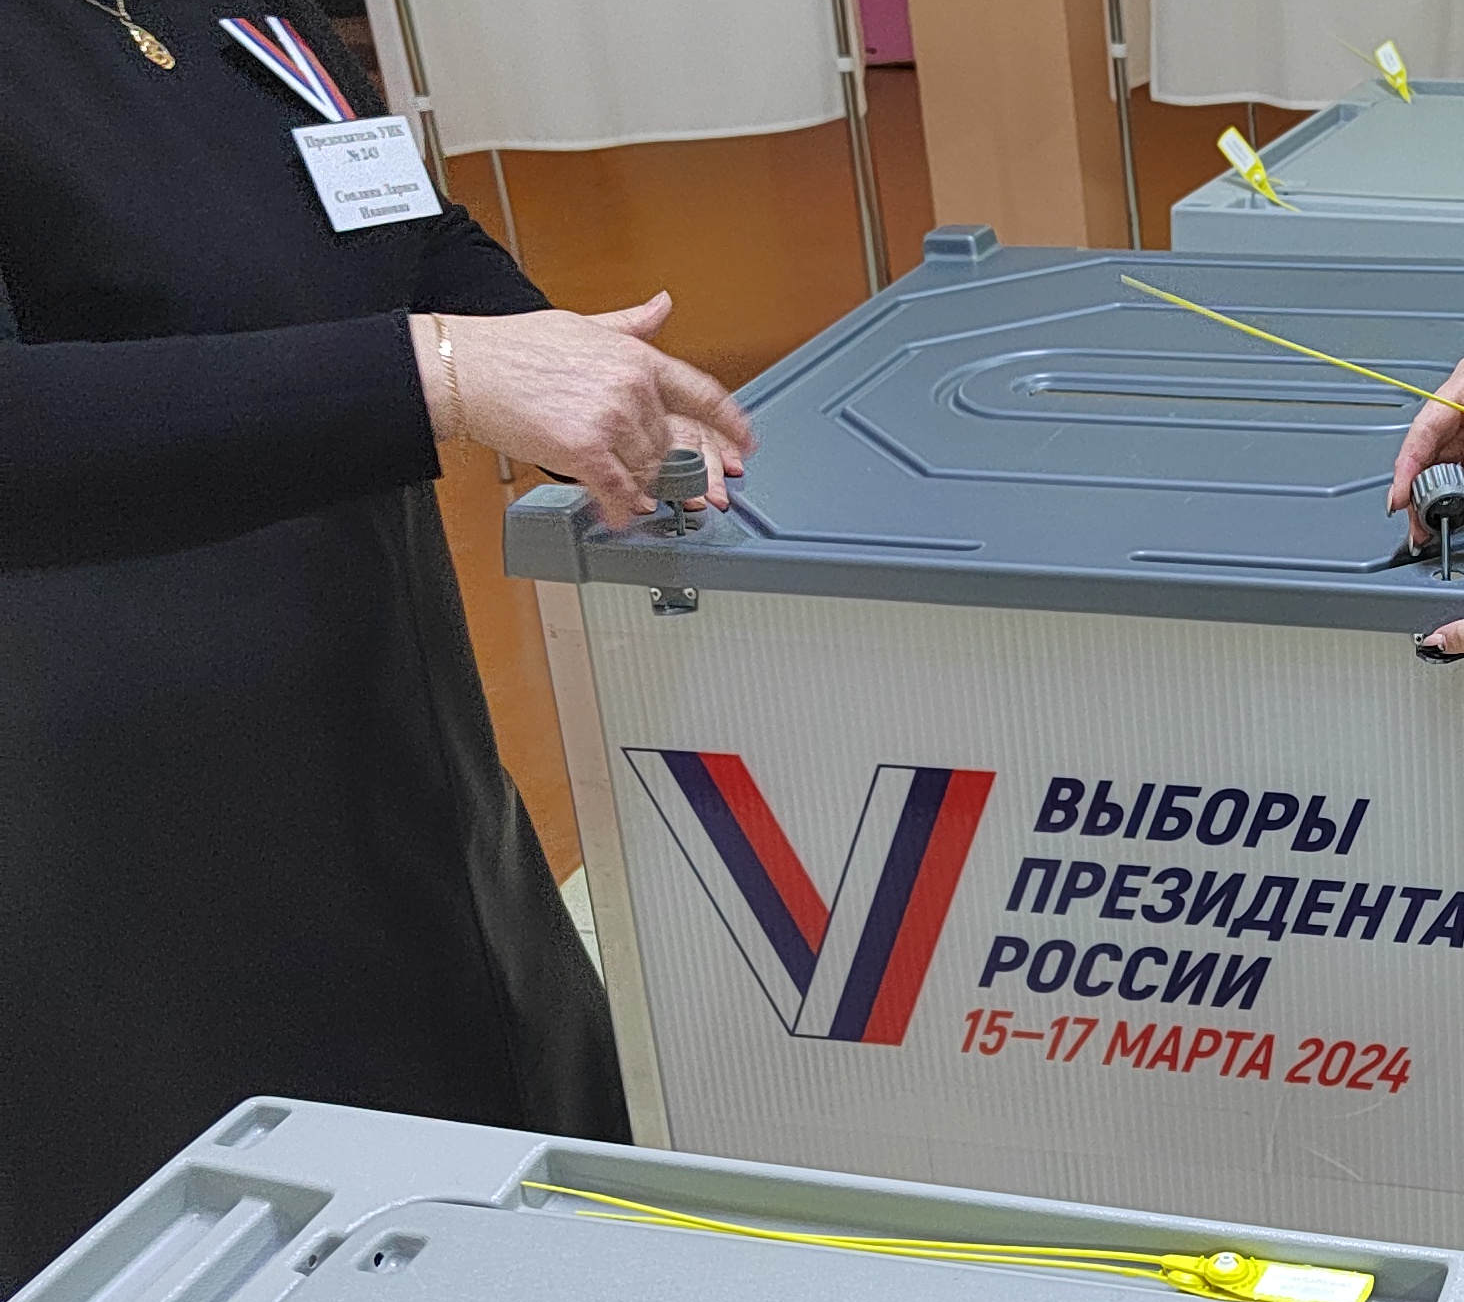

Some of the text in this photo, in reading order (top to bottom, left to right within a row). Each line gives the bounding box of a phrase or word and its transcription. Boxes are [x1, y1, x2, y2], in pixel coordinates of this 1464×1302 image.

[1033, 776, 1371, 855] ВЫБОРЫ
[978, 935, 1273, 1010] РОССИИ
[1103, 1020, 1275, 1080] МАРТА
[1285, 1037, 1410, 1094] 2024
